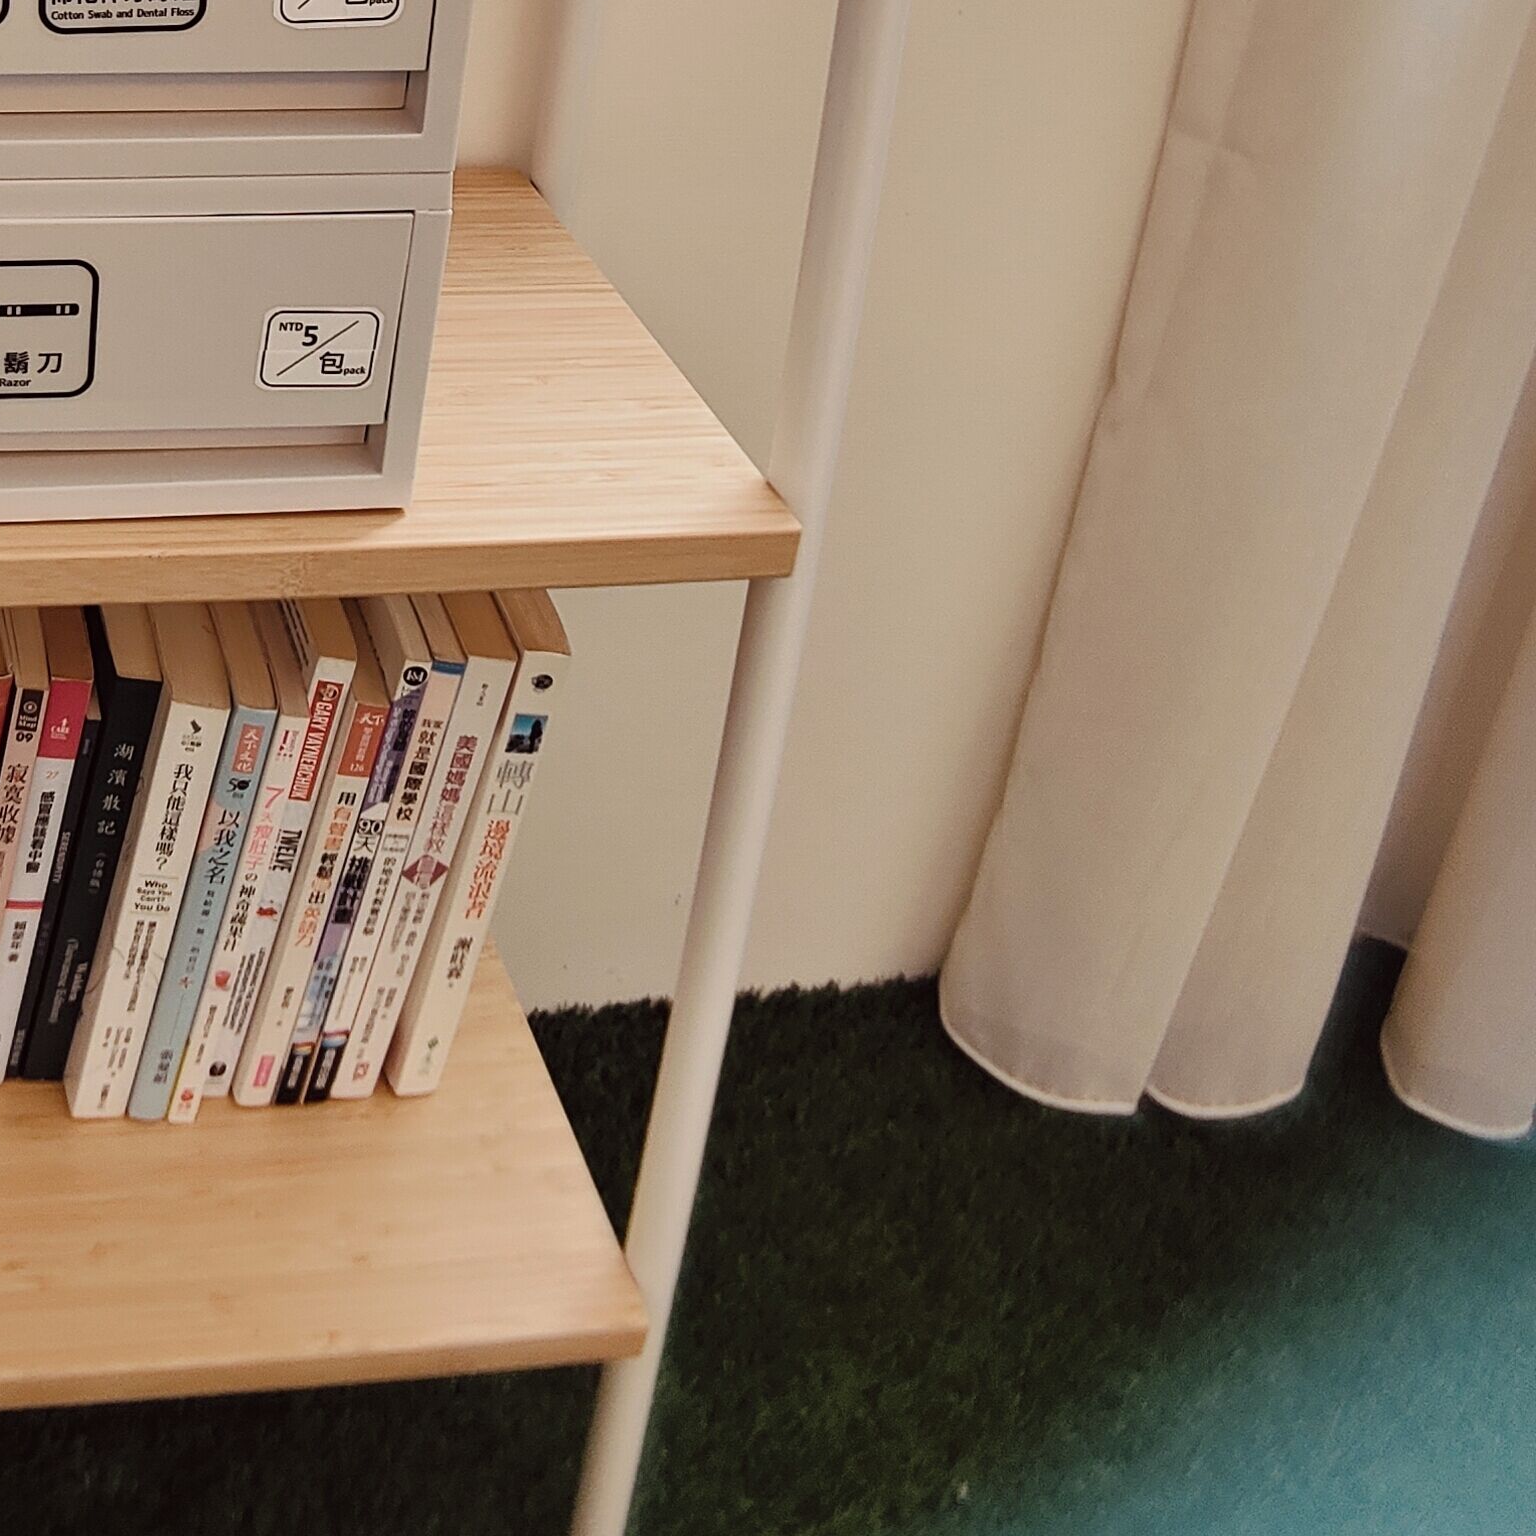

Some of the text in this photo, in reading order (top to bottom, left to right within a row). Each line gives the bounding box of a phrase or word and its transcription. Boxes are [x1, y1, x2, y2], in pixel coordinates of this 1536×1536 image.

[51, 7, 195, 20] Cotton Swab and Dental Floss
[279, 322, 319, 347] NTD 5
[319, 351, 366, 375] 包 pack
[310, 701, 333, 728] GARY
[15, 732, 34, 743] 09
[96, 743, 135, 836] 湖濱散記
[487, 759, 535, 815] 轉山
[203, 809, 241, 885] 以我之名
[272, 829, 303, 873] TWELVE
[145, 880, 168, 888] Who
[135, 902, 170, 912] You Do
